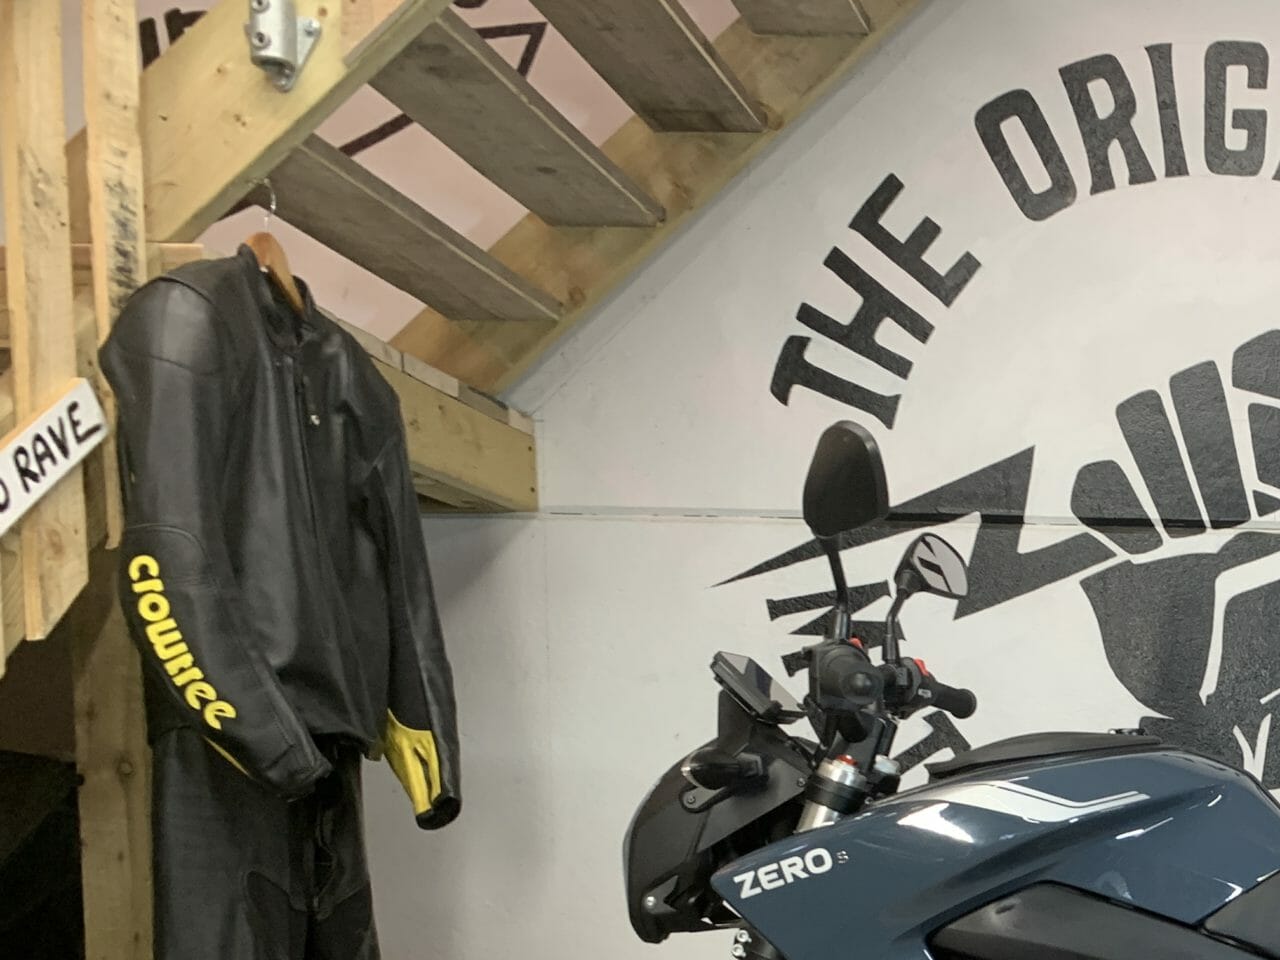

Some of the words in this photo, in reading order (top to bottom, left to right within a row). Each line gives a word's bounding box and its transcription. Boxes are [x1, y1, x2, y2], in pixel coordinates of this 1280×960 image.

[769, 172, 982, 430] THE
[12, 401, 103, 494] RAVE
[732, 847, 833, 899] ZERO
